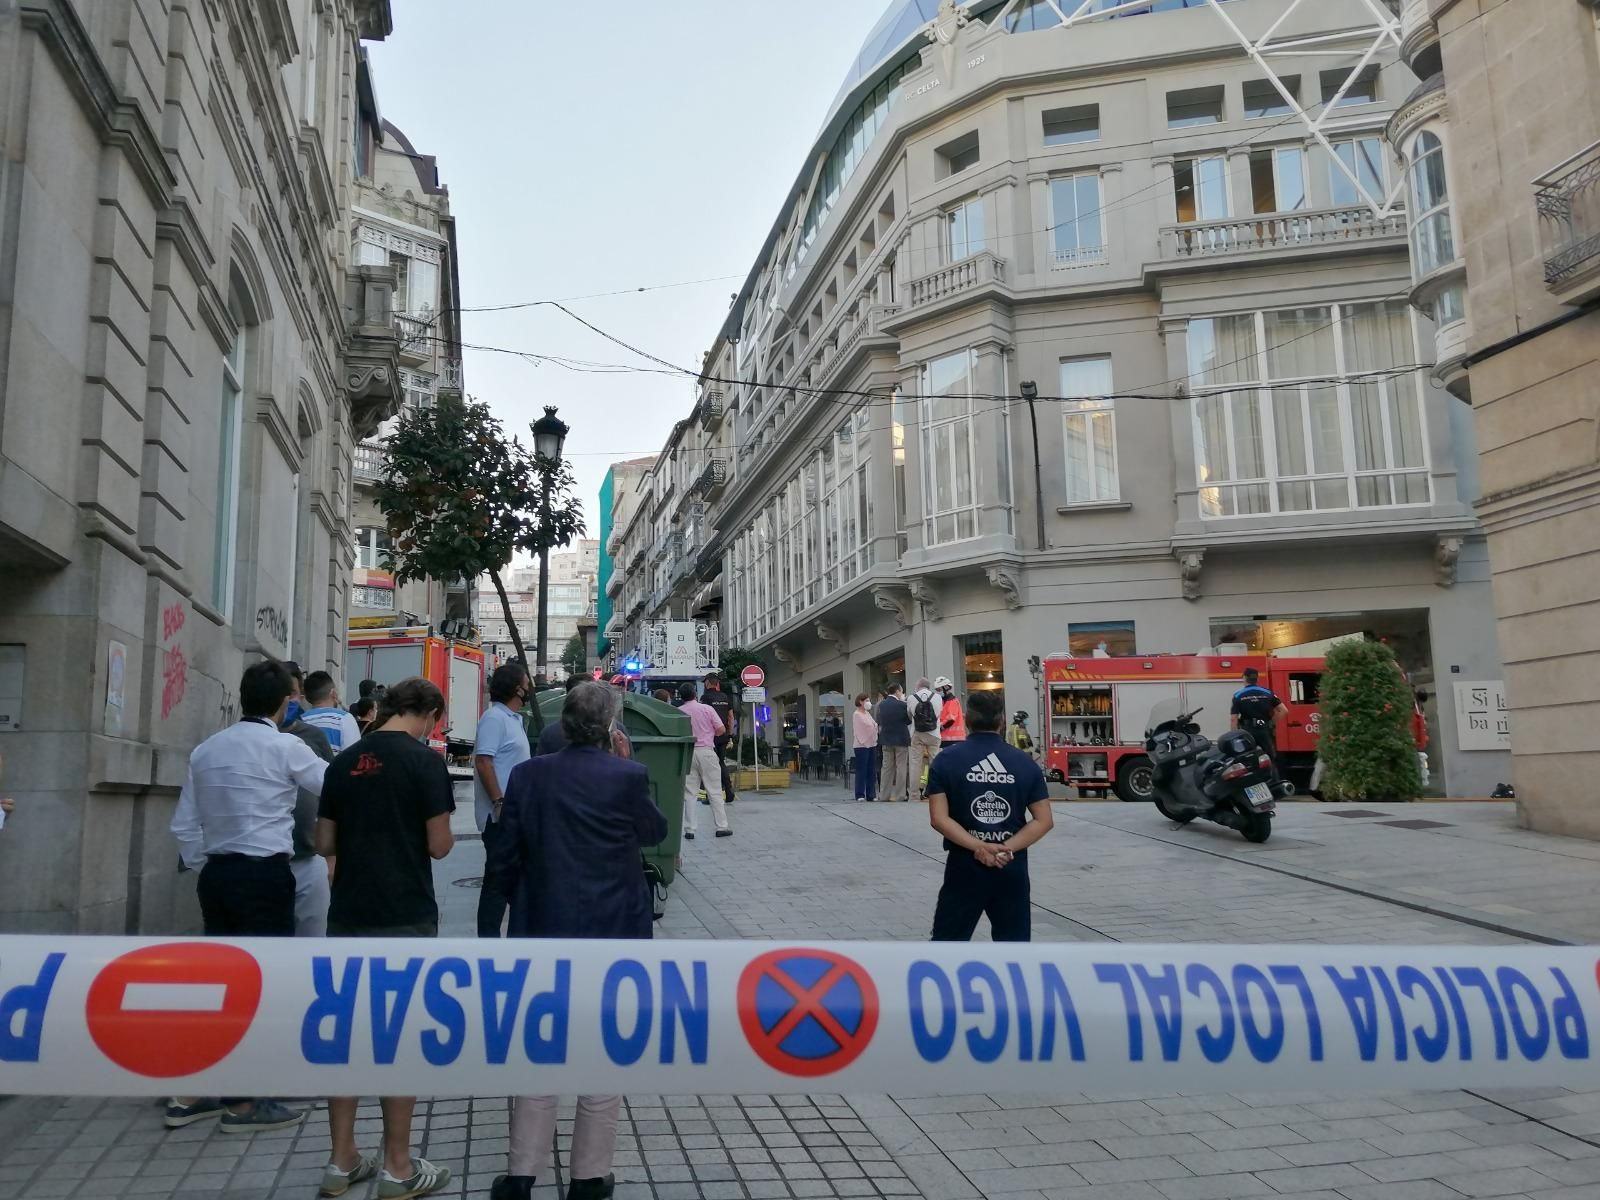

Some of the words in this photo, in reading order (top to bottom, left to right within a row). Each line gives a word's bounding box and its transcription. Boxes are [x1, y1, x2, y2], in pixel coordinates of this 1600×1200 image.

[917, 79, 941, 95] CELTA
[1468, 715, 1489, 730] ba
[966, 771, 1015, 784] adidas
[976, 801, 1006, 809] Estrella
[977, 808, 1004, 817] Galicia
[299, 954, 573, 1067] PASAR
[599, 957, 710, 1067] NO
[906, 960, 1087, 1064] VIGO
[1092, 962, 1324, 1064] LOCAL
[1322, 964, 1590, 1063] POLICIA
